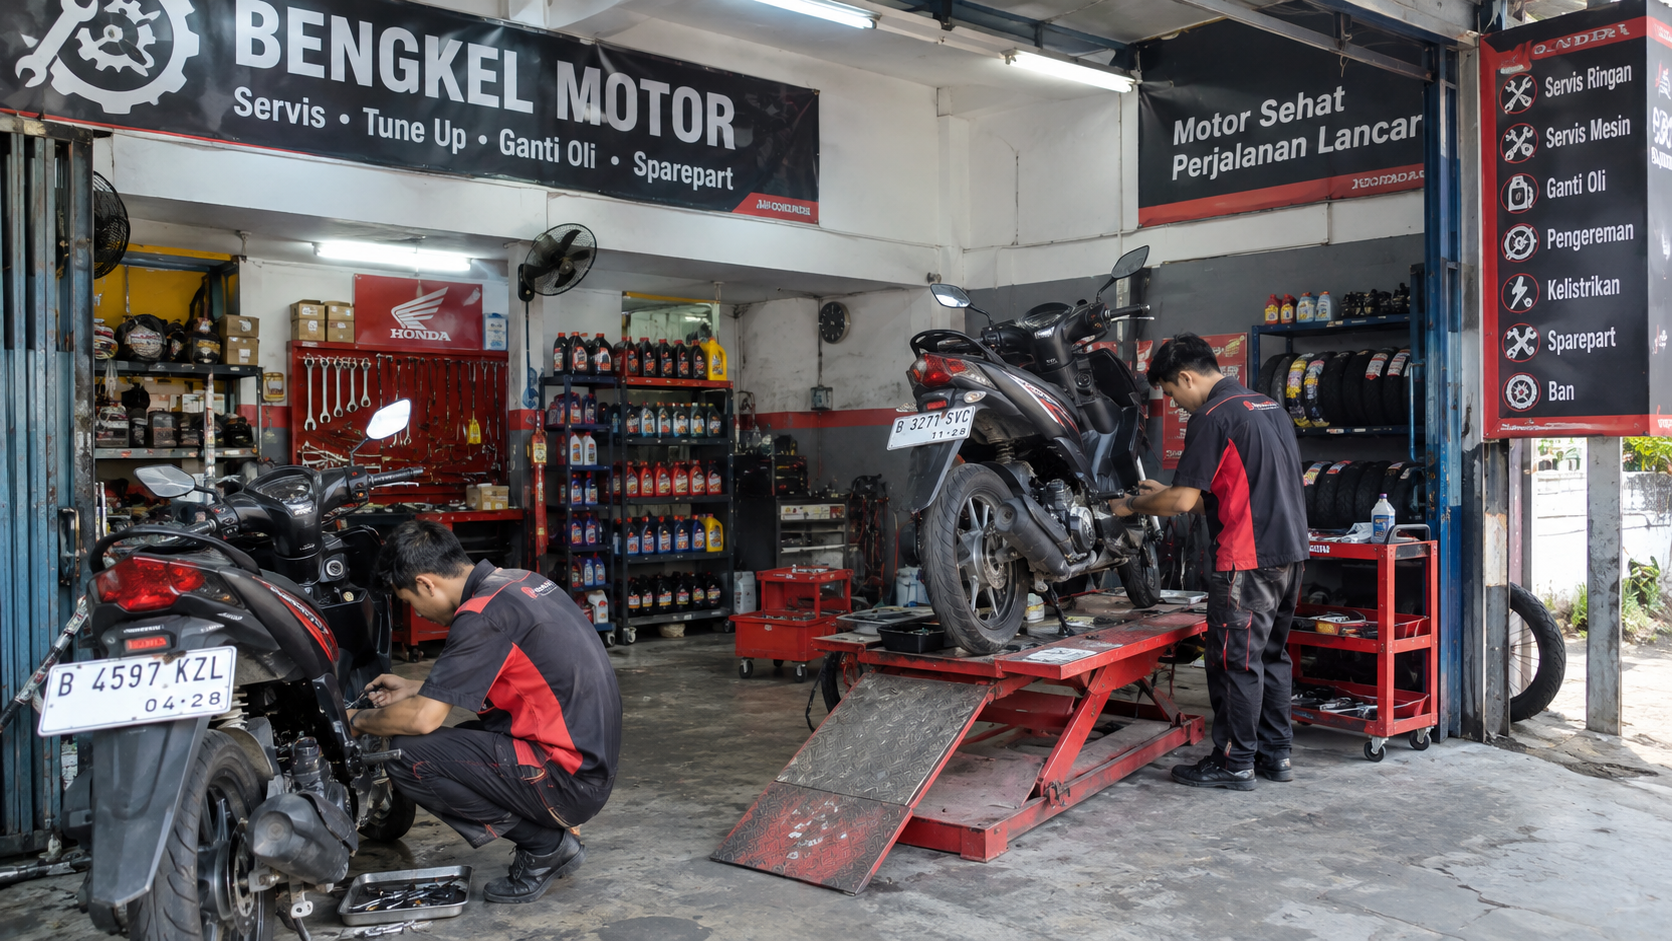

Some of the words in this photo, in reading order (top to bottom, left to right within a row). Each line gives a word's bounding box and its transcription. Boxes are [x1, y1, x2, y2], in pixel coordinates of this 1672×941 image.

[235, 0, 533, 114] BENGKEL
[556, 60, 736, 150] MOTOR
[1545, 71, 1584, 98] Servis
[1587, 64, 1632, 91] Ringan
[1173, 109, 1251, 146] Motor
[1259, 86, 1345, 128] Sehat
[1546, 122, 1586, 148] Servis
[1590, 115, 1631, 141] Mesin
[234, 86, 326, 129] Servis
[362, 107, 425, 144] Tune
[434, 118, 467, 154] Up
[499, 128, 560, 163] Ganti
[567, 140, 596, 169] Oli
[633, 151, 734, 190] Sparepart
[1171, 136, 1307, 181] Perjalanan
[1317, 113, 1423, 154] Lancar
[1546, 173, 1582, 199] Ganti
[1588, 169, 1606, 193] Oli
[1547, 223, 1634, 251] Pengereman
[1547, 275, 1620, 301] Kelistrikan
[390, 328, 451, 341] HONDA
[1548, 327, 1616, 355] Sparepart
[1549, 381, 1575, 401] Ban
[896, 420, 904, 434] B
[946, 409, 970, 425] SVC
[58, 672, 74, 697] B
[92, 661, 161, 692] 4597
[175, 655, 223, 684] KZL
